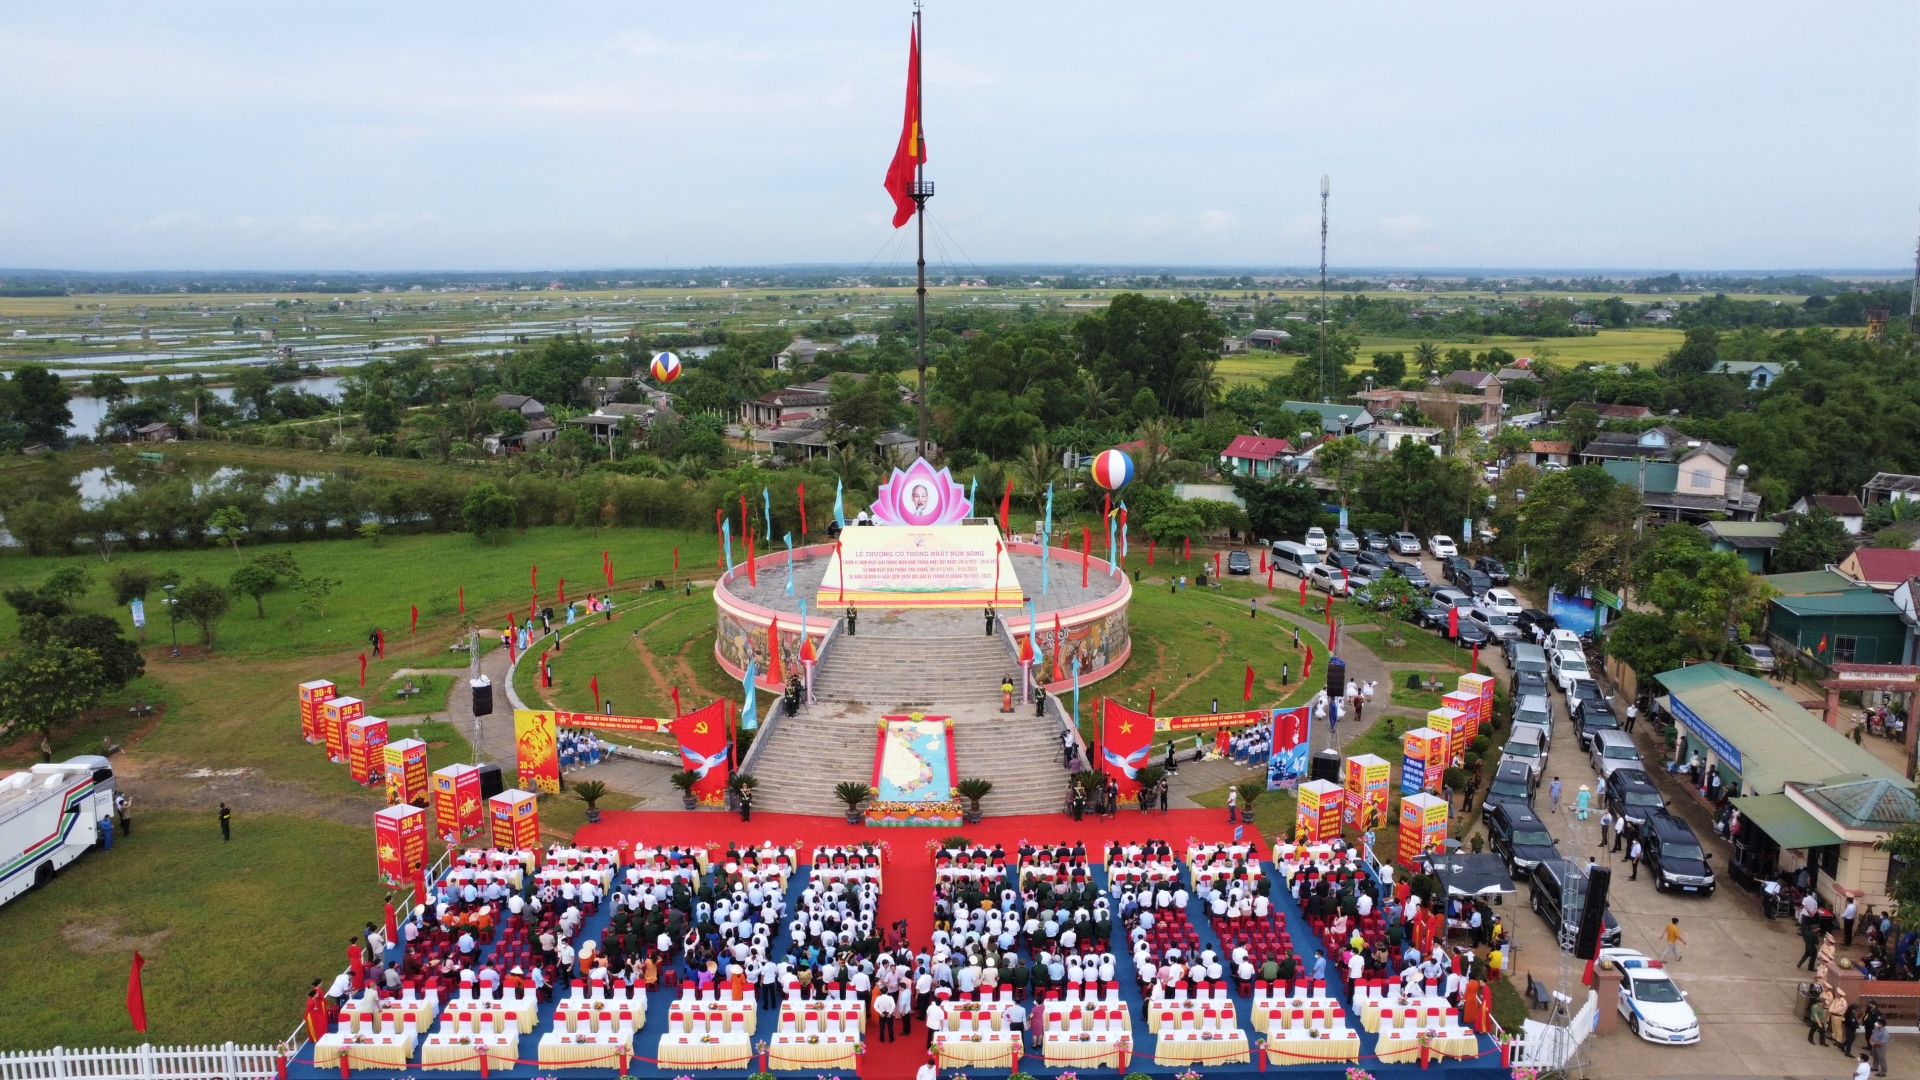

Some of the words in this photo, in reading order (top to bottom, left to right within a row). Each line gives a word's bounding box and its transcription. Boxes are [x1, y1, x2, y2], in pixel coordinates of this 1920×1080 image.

[327, 708, 336, 718] 50
[1293, 757, 1306, 771] 47
[438, 778, 450, 790] 50
[519, 802, 532, 816] 50
[1404, 806, 1416, 821] 50
